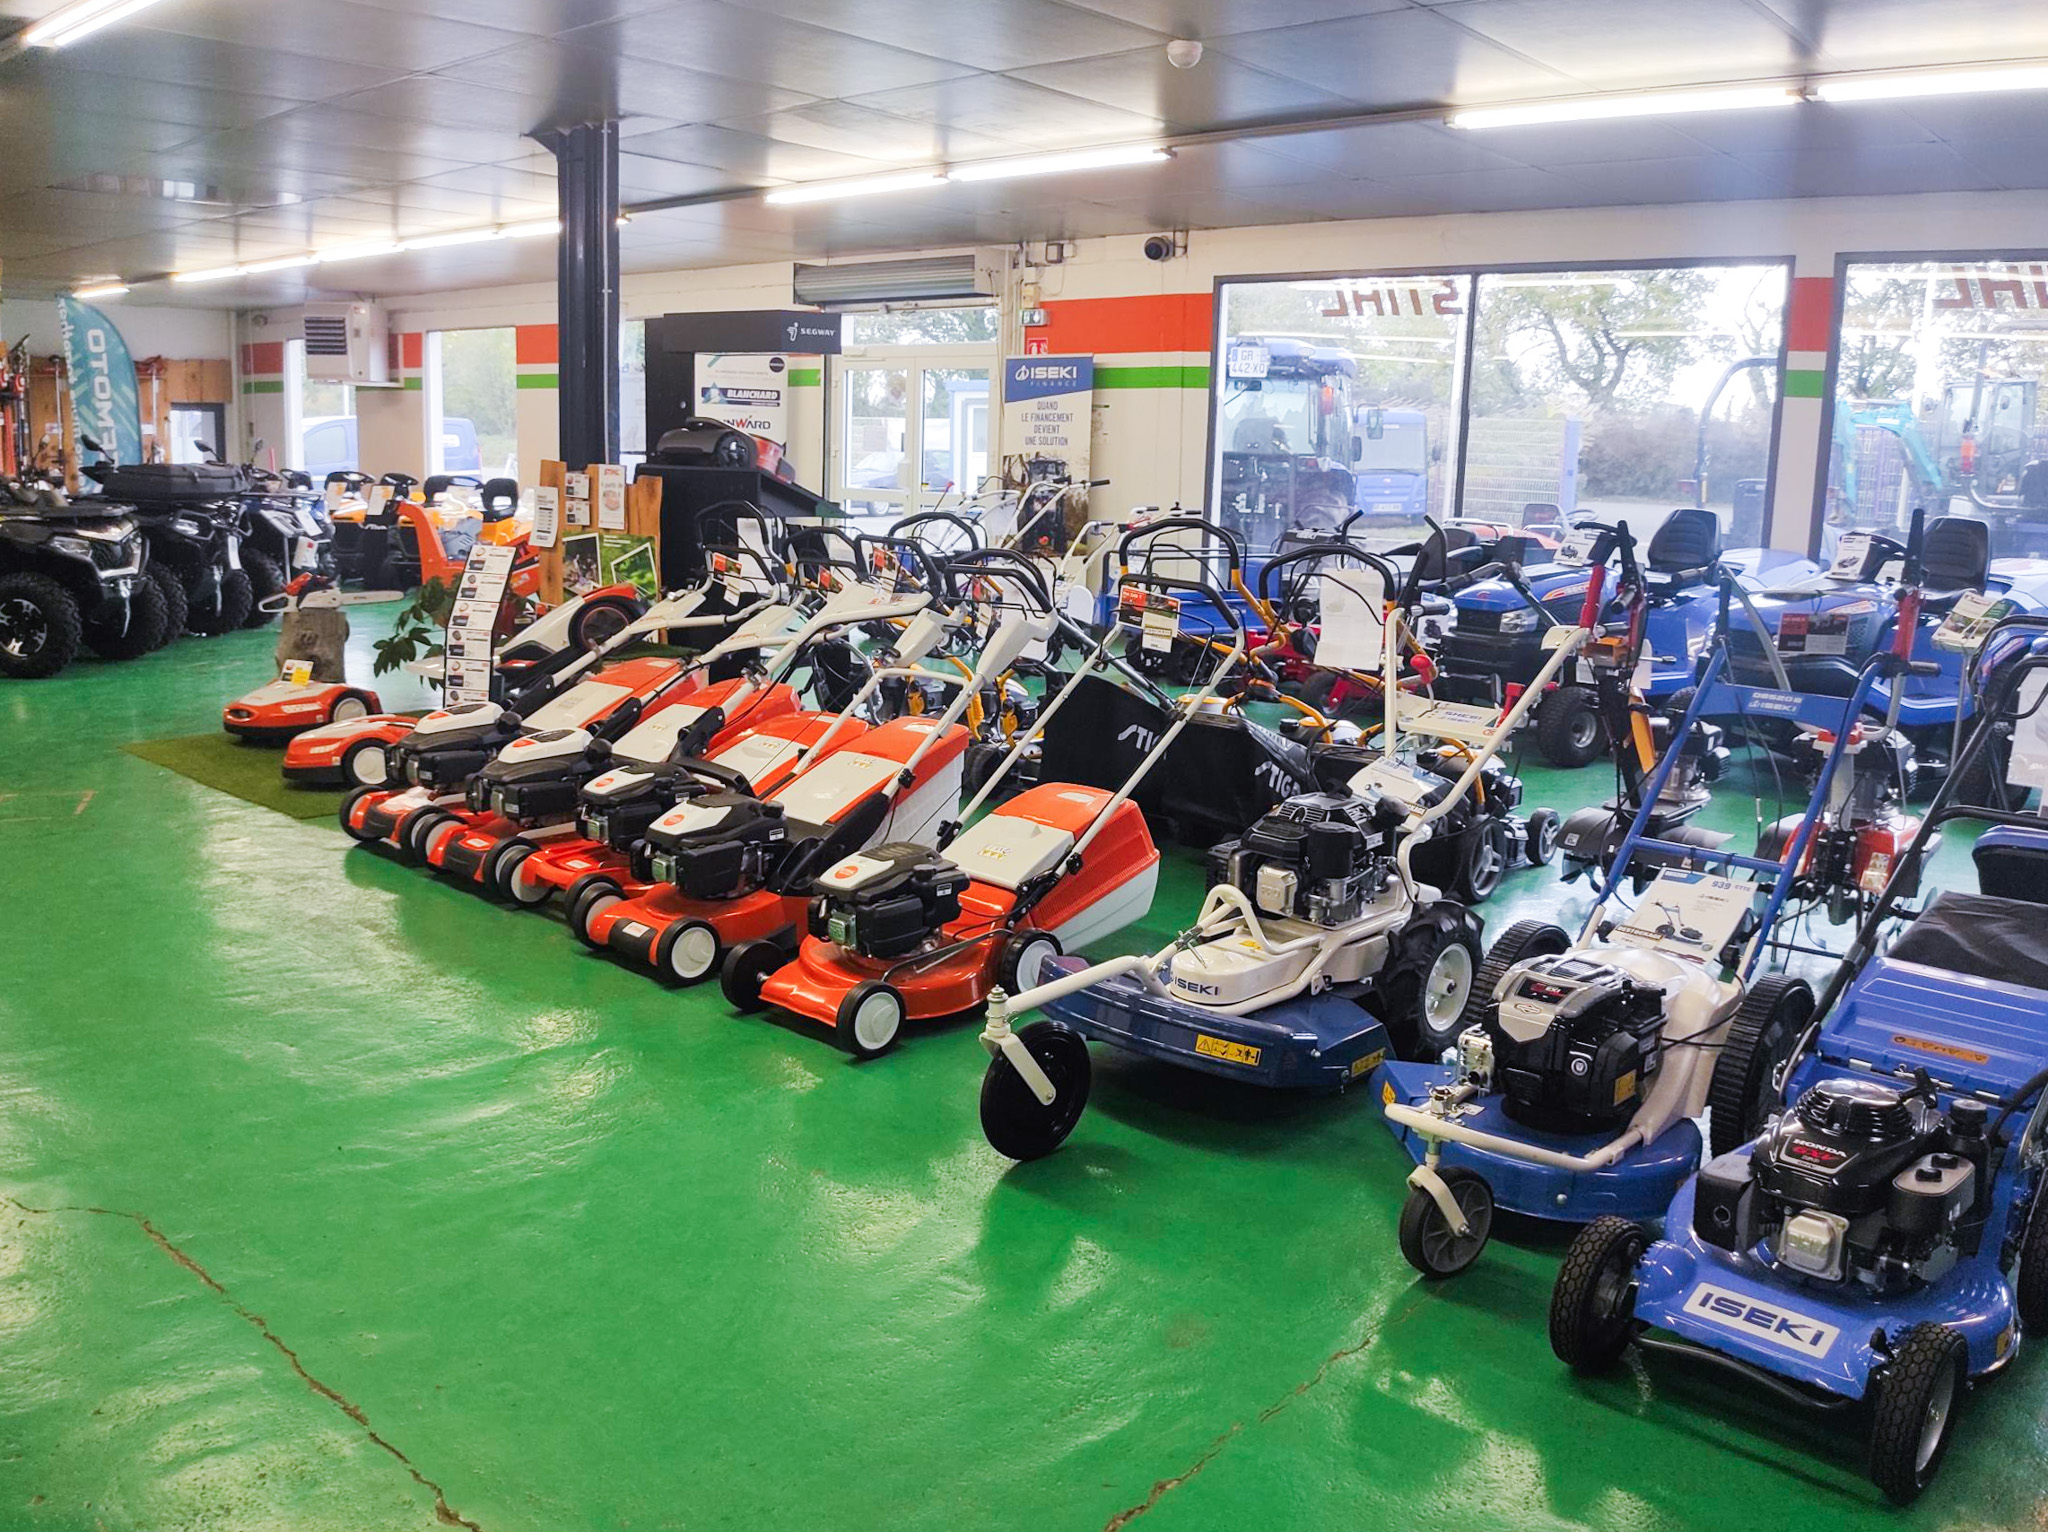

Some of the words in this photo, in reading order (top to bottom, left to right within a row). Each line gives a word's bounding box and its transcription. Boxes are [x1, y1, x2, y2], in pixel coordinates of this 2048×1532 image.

[800, 327, 836, 337] SEGWAY
[1030, 366, 1077, 379] ISEKI
[726, 388, 778, 400] BLANCHARD
[1037, 401, 1058, 410] QUAND
[722, 415, 771, 430] NWARD
[1021, 413, 1029, 422] LE
[1030, 413, 1074, 422] FINANCEMENT
[1034, 424, 1060, 434] DEVIENT
[1024, 436, 1037, 446] UNE
[1038, 436, 1068, 446] SOLUTION
[1760, 701, 1797, 712] ISEKI
[1711, 880, 1732, 890] 939
[1174, 975, 1219, 996] ISEKI
[1792, 1138, 1848, 1158] HONDA
[1698, 1292, 1825, 1347] ISEKI
